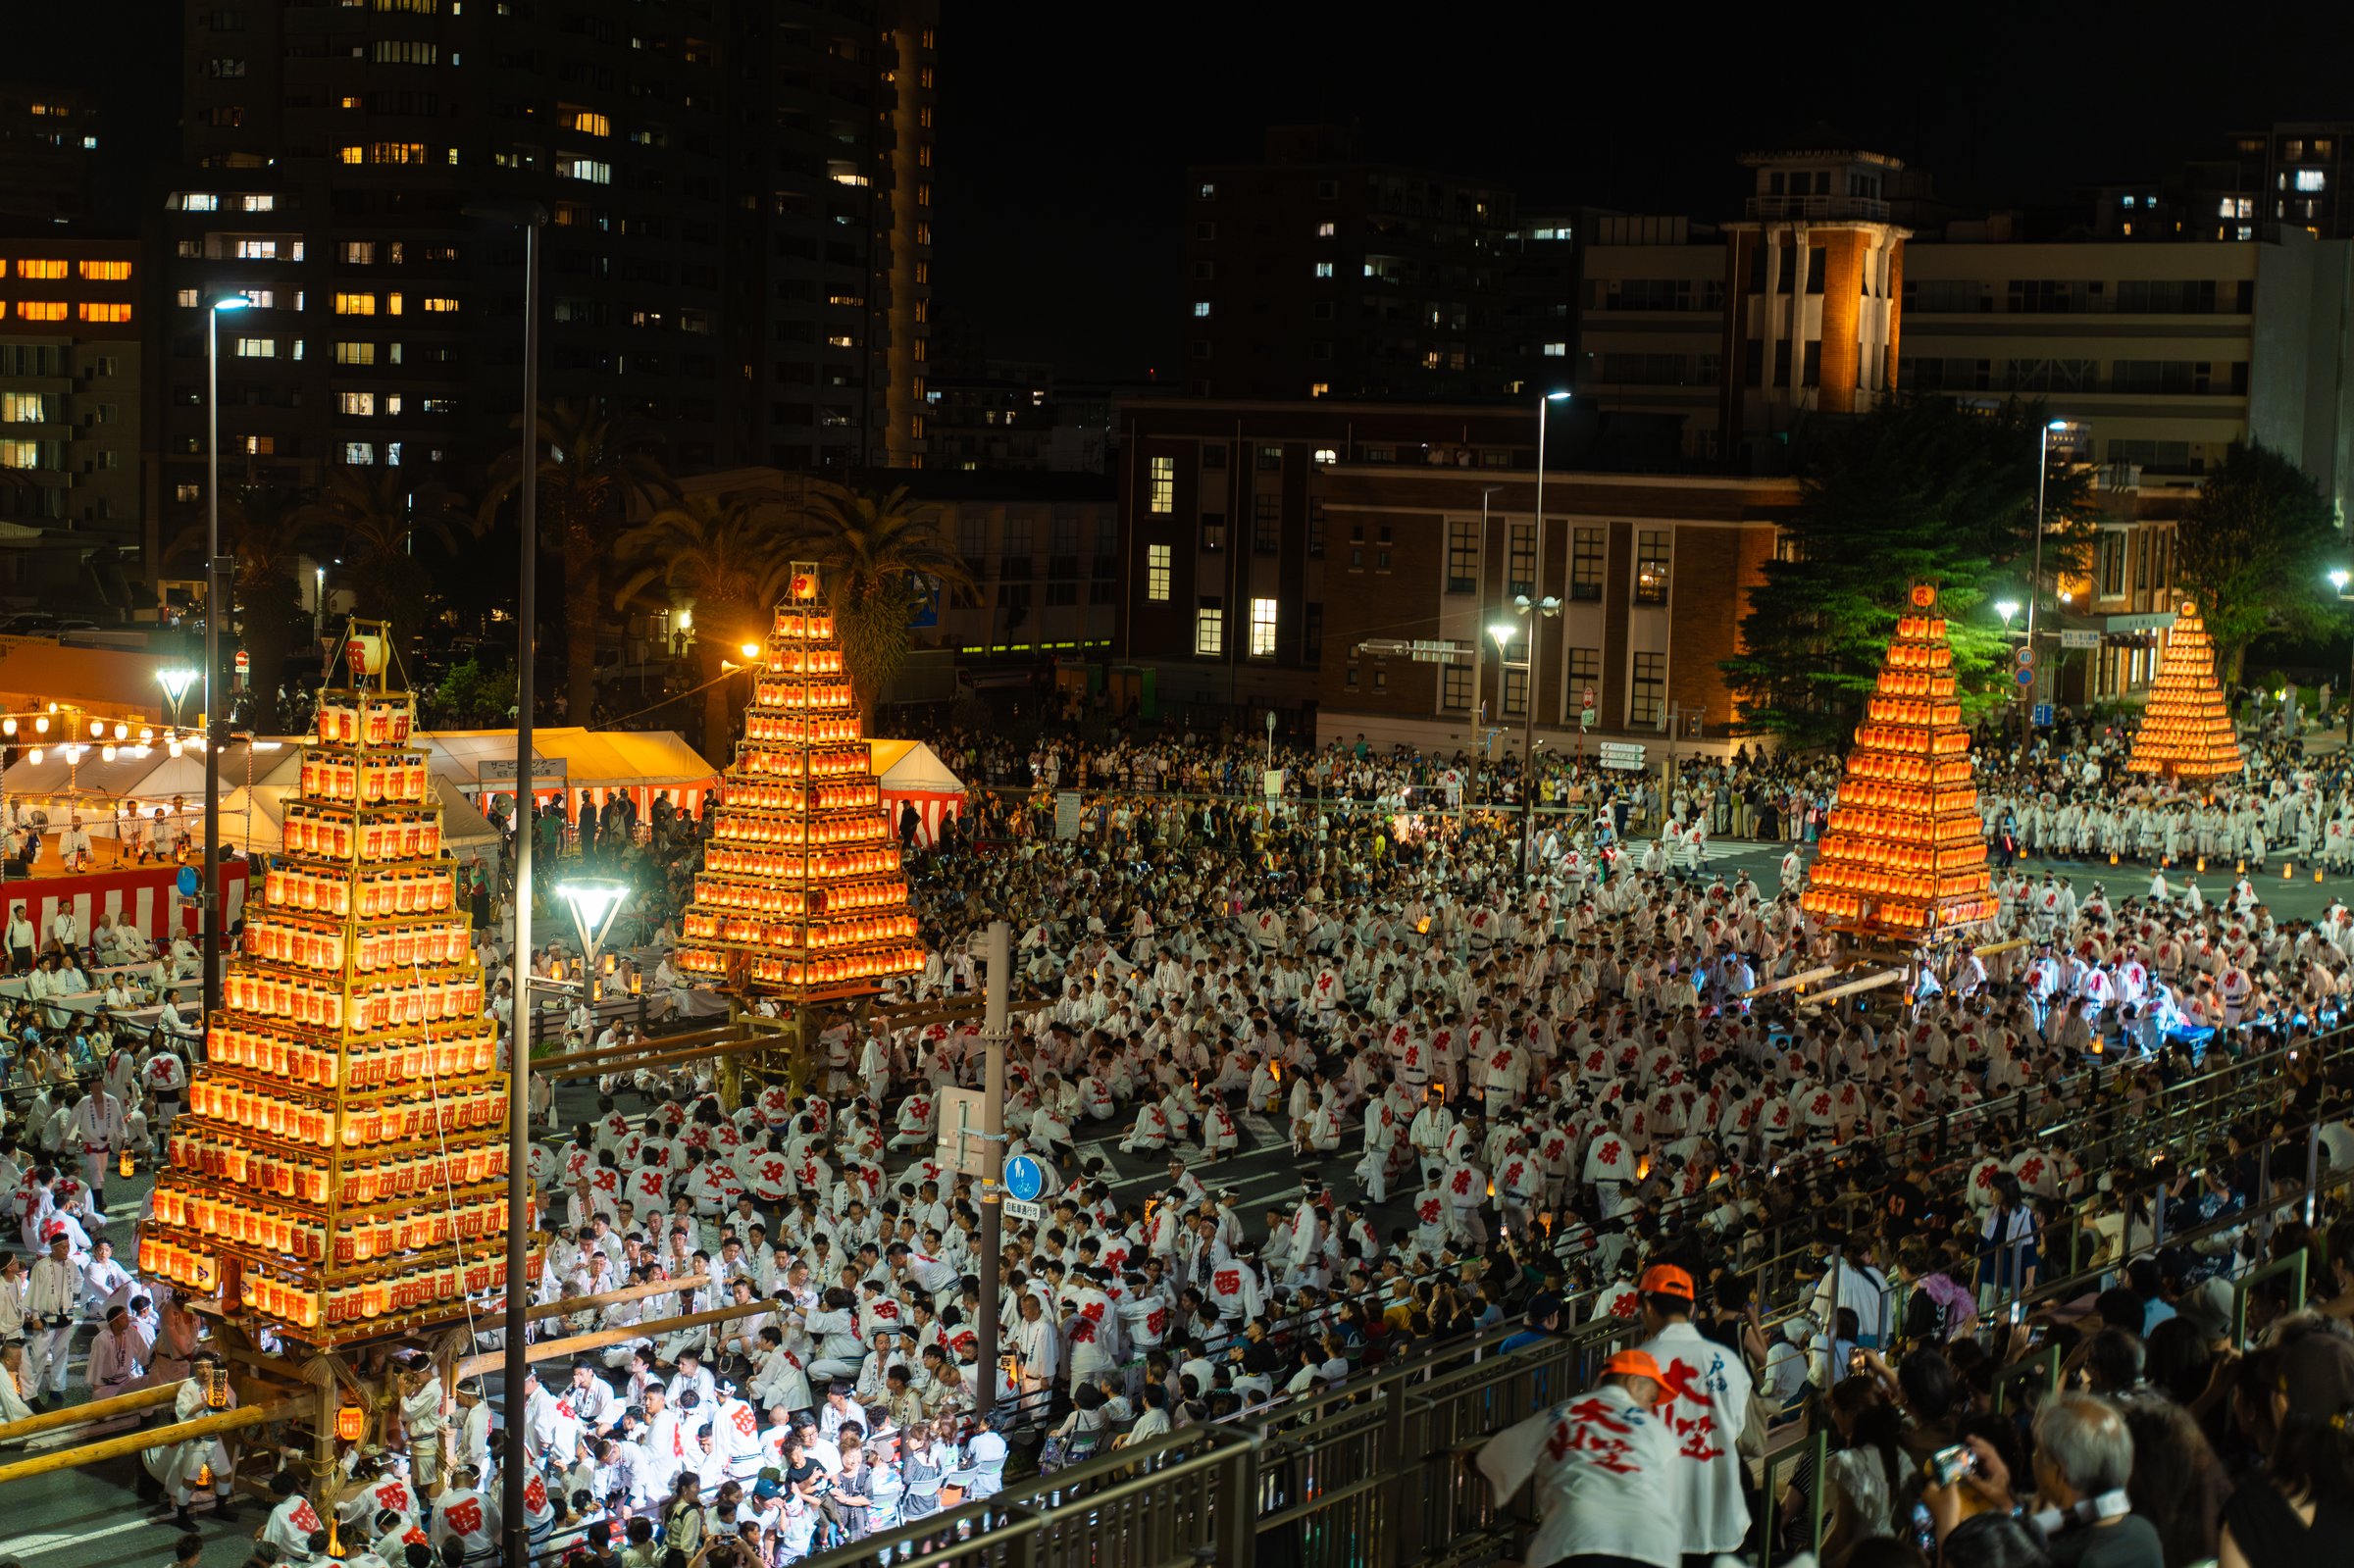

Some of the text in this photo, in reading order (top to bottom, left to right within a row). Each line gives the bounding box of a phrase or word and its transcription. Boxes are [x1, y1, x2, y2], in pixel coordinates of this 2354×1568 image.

[346, 641, 366, 673] 西
[2021, 652, 2031, 662] 40
[371, 717, 386, 739] 西
[393, 716, 409, 739] 西
[320, 770, 331, 797] 西
[337, 771, 353, 798] 西
[369, 774, 384, 797] 西
[389, 772, 404, 796] 西
[410, 771, 424, 794] 西
[368, 832, 382, 856] 西
[384, 831, 400, 853] 西
[406, 829, 420, 852] 西
[423, 827, 438, 851] 西
[366, 888, 380, 913] 西
[381, 885, 397, 910] 西
[400, 885, 416, 908] 西
[417, 885, 433, 908] 西
[435, 883, 451, 903] 西
[362, 943, 379, 967] 西
[379, 939, 394, 963] 西
[397, 937, 414, 961] 西
[415, 936, 431, 959] 西
[431, 935, 448, 957] 西
[453, 934, 469, 957] 西
[1317, 973, 1333, 996] 中
[374, 997, 389, 1018] 西
[394, 996, 408, 1020] 西
[428, 993, 444, 1017] 西
[449, 990, 463, 1013] 西
[465, 988, 480, 1011] 西
[406, 1052, 423, 1075] 西
[441, 1048, 458, 1070] 西
[460, 1046, 476, 1069] 西
[480, 1043, 493, 1066] 西
[351, 1061, 367, 1085] 西
[369, 1058, 385, 1081] 西
[388, 1055, 403, 1078] 西
[422, 1108, 436, 1132] 西
[442, 1104, 454, 1128] 西
[458, 1103, 472, 1126] 西
[472, 1099, 489, 1122] 西
[491, 1097, 507, 1120] 西
[908, 1097, 931, 1125] 中
[348, 1119, 365, 1142] 西
[367, 1116, 382, 1139] 西
[384, 1114, 401, 1137] 西
[404, 1110, 419, 1134] 西
[451, 1157, 468, 1181] 西
[470, 1154, 485, 1179] 西
[487, 1151, 502, 1175] 西
[360, 1176, 377, 1199] 西
[379, 1173, 396, 1195] 西
[396, 1168, 414, 1191] 西
[418, 1165, 434, 1188] 西
[344, 1177, 360, 1200] 西
[488, 1208, 500, 1232] 西
[1006, 1203, 1038, 1218] 自転車通行可
[411, 1221, 429, 1243] 西
[433, 1218, 446, 1240] 西
[466, 1211, 483, 1236] 西
[358, 1231, 374, 1255] 西
[375, 1229, 392, 1255] 西
[399, 1226, 412, 1247] 西
[335, 1238, 354, 1260] 西
[474, 1266, 488, 1290] 西
[494, 1262, 506, 1286] 西
[527, 1255, 539, 1280] 西
[418, 1277, 435, 1300] 西
[440, 1275, 454, 1296] 西
[1214, 1270, 1240, 1295] 西
[346, 1293, 363, 1318] 西
[365, 1289, 383, 1313] 西
[389, 1286, 401, 1309] 西
[401, 1283, 420, 1306] 西
[328, 1296, 345, 1321] 西
[873, 1300, 898, 1320] 西
[1148, 1307, 1165, 1337] 西
[1707, 1352, 1728, 1392] 戸畑
[341, 1414, 361, 1437] 西
[732, 1404, 757, 1436] 西
[1570, 1398, 1631, 1434] 大
[1548, 1422, 1641, 1473] 山笠
[376, 1483, 408, 1511] 西
[524, 1475, 547, 1515] 西
[289, 1499, 322, 1534] 西
[444, 1497, 483, 1536] 西
